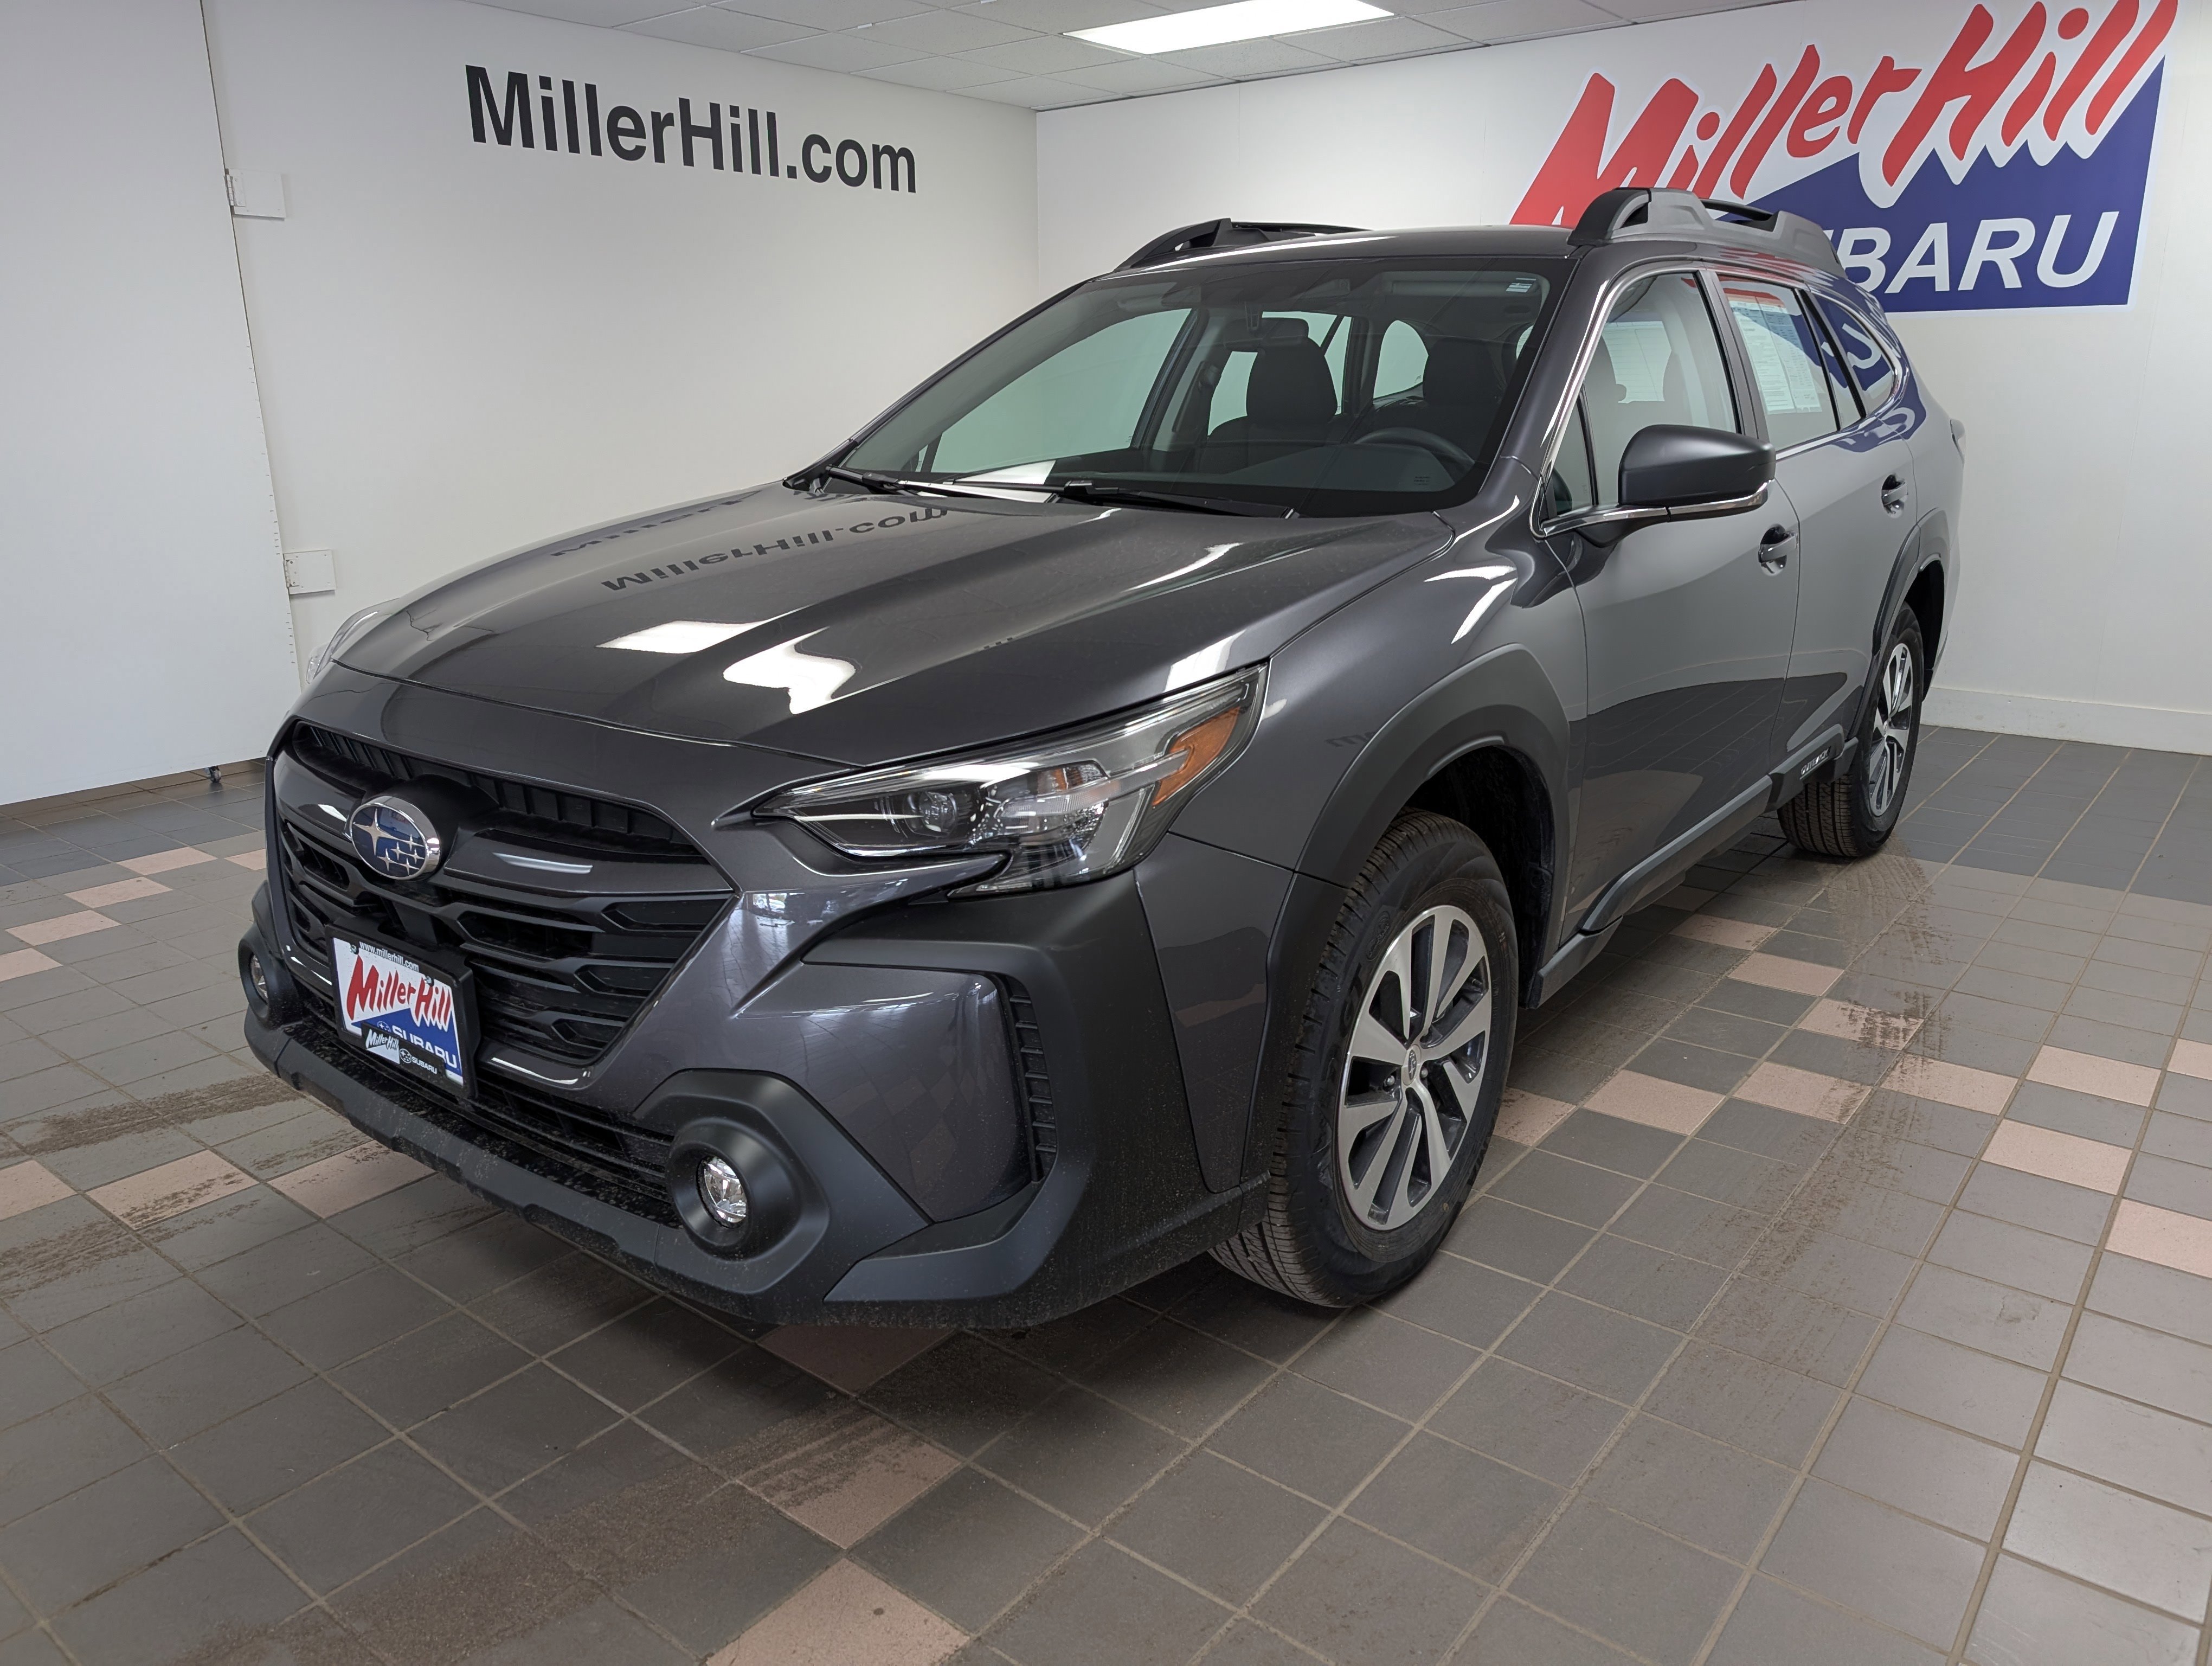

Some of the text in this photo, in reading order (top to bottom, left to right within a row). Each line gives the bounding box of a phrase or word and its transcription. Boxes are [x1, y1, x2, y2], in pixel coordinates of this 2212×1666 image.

[465, 65, 916, 193] MillerHill.com
[359, 941, 419, 972] www.millerhill.com
[411, 1056, 438, 1074] SUBARU
